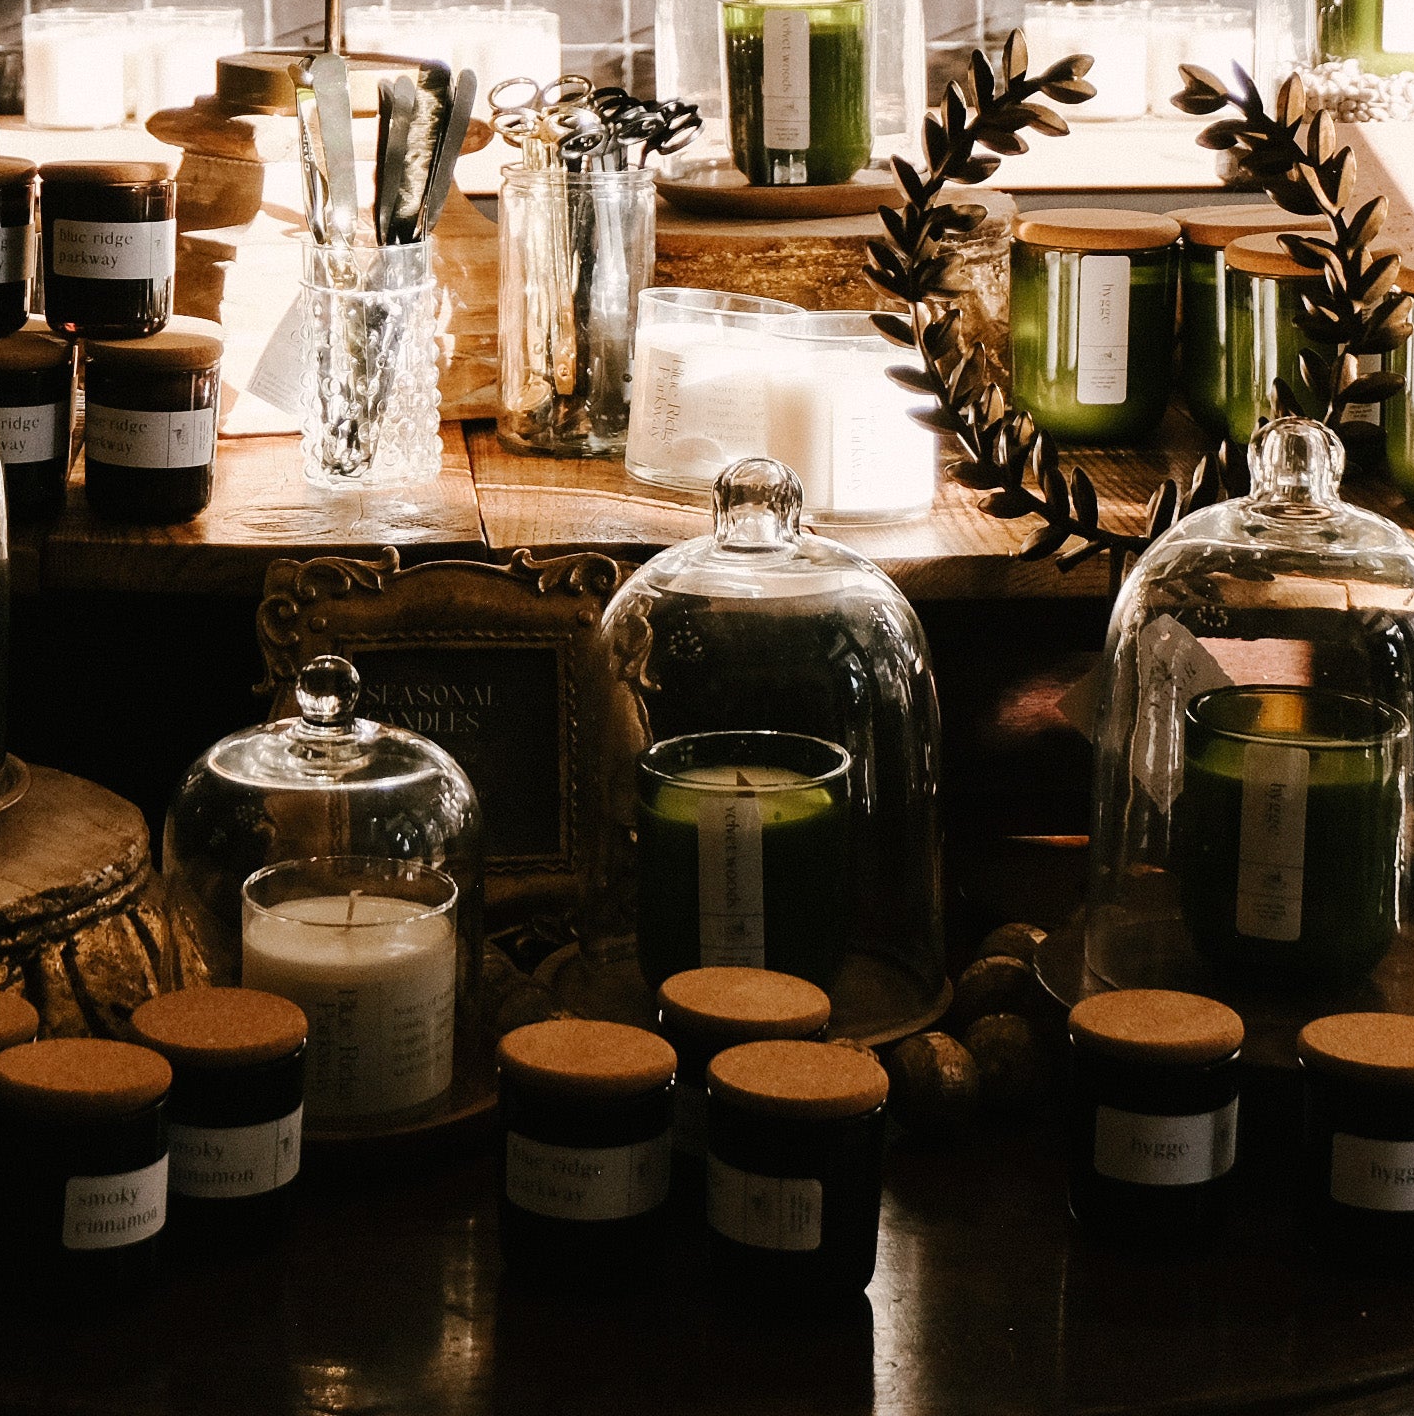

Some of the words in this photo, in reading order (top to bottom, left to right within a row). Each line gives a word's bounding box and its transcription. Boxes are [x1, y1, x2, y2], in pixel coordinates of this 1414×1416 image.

[781, 16, 792, 52] velvet
[781, 54, 793, 94] woods
[59, 227, 89, 245] blue
[94, 230, 134, 249] ridge
[59, 248, 119, 270] parkway
[1100, 283, 1114, 325] hygge
[1, 416, 39, 432] ridge
[109, 419, 147, 435] ridge
[366, 684, 498, 706] SEASONAL
[725, 805, 740, 852] velvet
[726, 856, 741, 909] woods
[172, 1140, 225, 1164] moky
[1131, 1135, 1189, 1161] hygge
[77, 1185, 138, 1207] smoky
[75, 1207, 158, 1235] cinnamon
